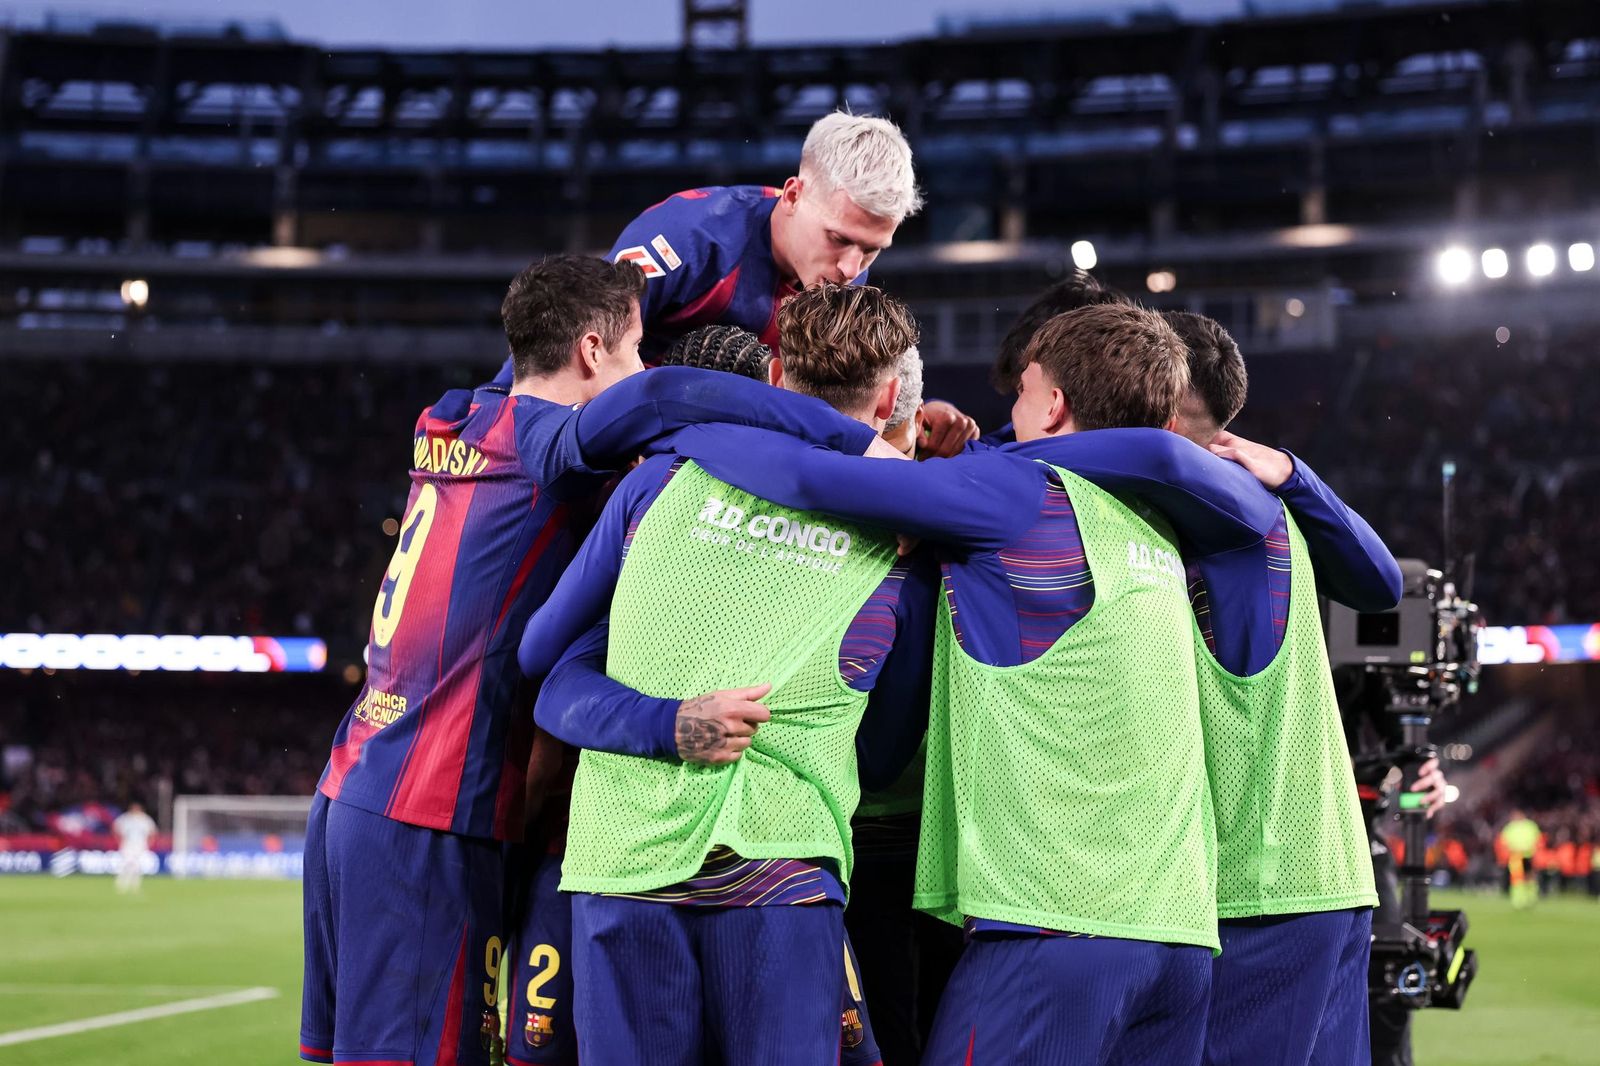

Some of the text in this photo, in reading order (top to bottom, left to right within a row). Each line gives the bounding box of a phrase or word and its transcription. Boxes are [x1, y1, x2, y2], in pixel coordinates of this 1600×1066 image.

[373, 482, 437, 648] 9
[735, 539, 757, 554] DE
[747, 514, 850, 557] CONGO
[483, 935, 502, 1007] 9
[526, 943, 561, 1010] 2
